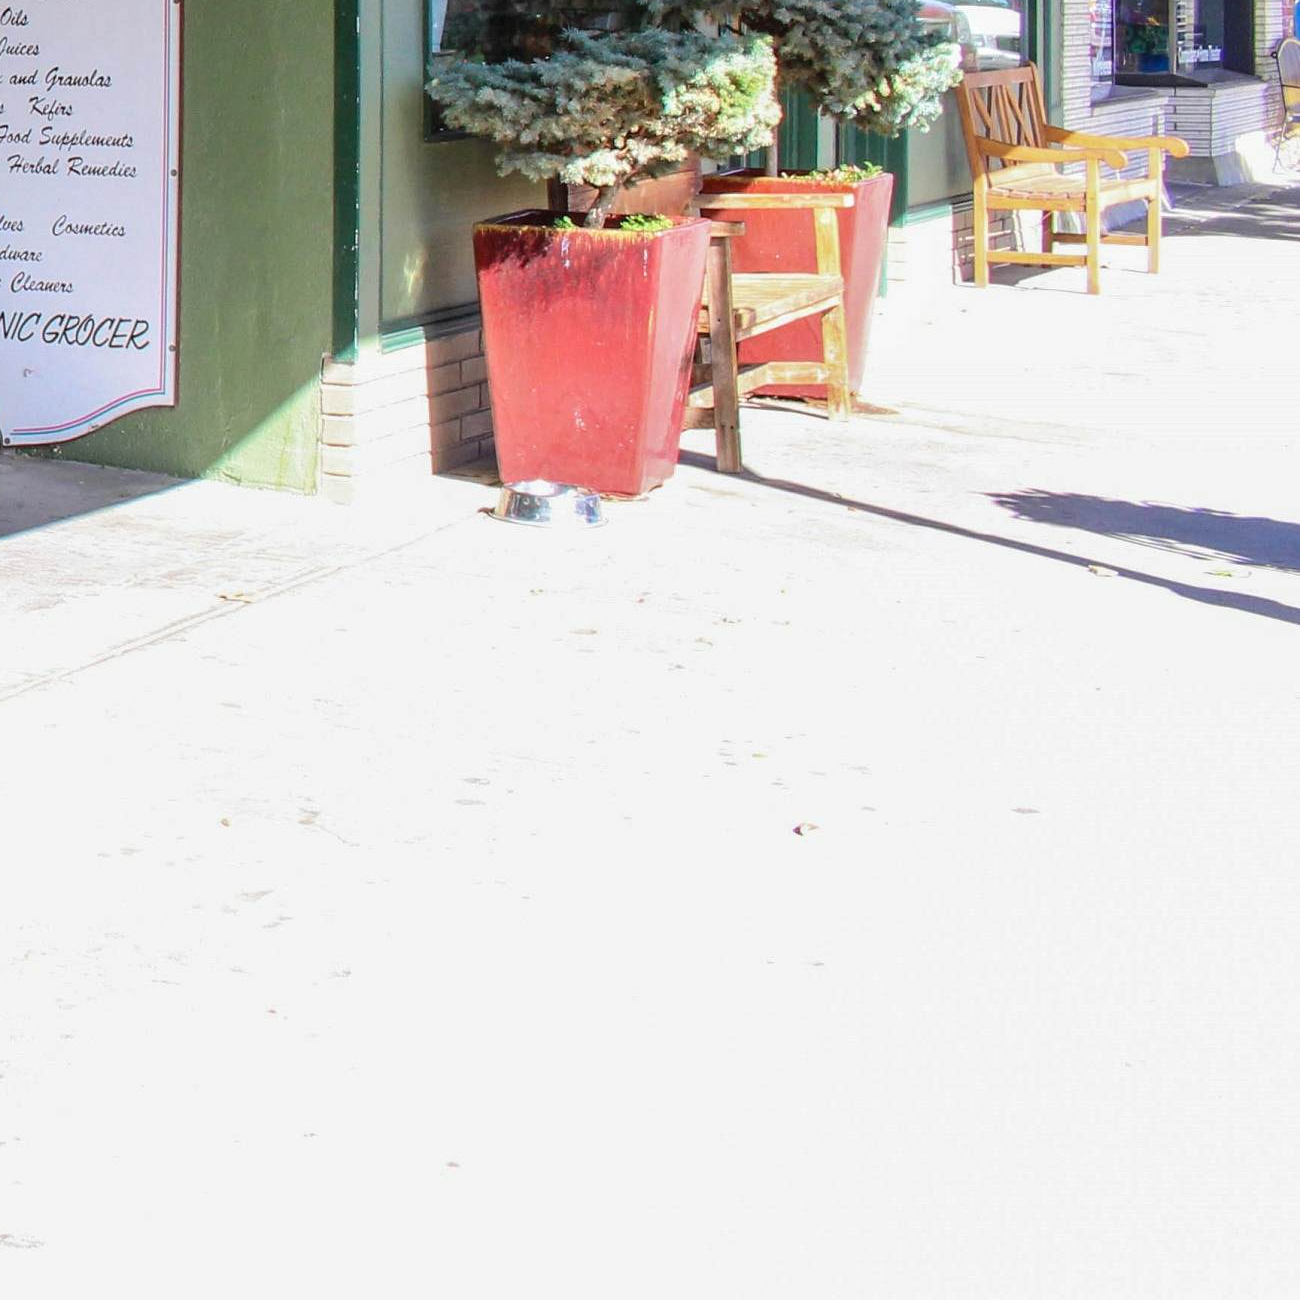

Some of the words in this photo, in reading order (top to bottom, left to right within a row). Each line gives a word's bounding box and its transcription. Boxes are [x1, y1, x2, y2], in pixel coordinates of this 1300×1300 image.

[0, 6, 30, 27] Oils
[8, 69, 39, 86] and
[44, 66, 113, 91] Granolas
[28, 95, 73, 122] Kefirs
[38, 125, 134, 152] Supplements
[6, 153, 60, 175] Herbal
[66, 156, 137, 179] Remedies
[51, 214, 127, 238] Cosmetics
[10, 270, 74, 294] Cleaners
[41, 315, 150, 351] GROCER
